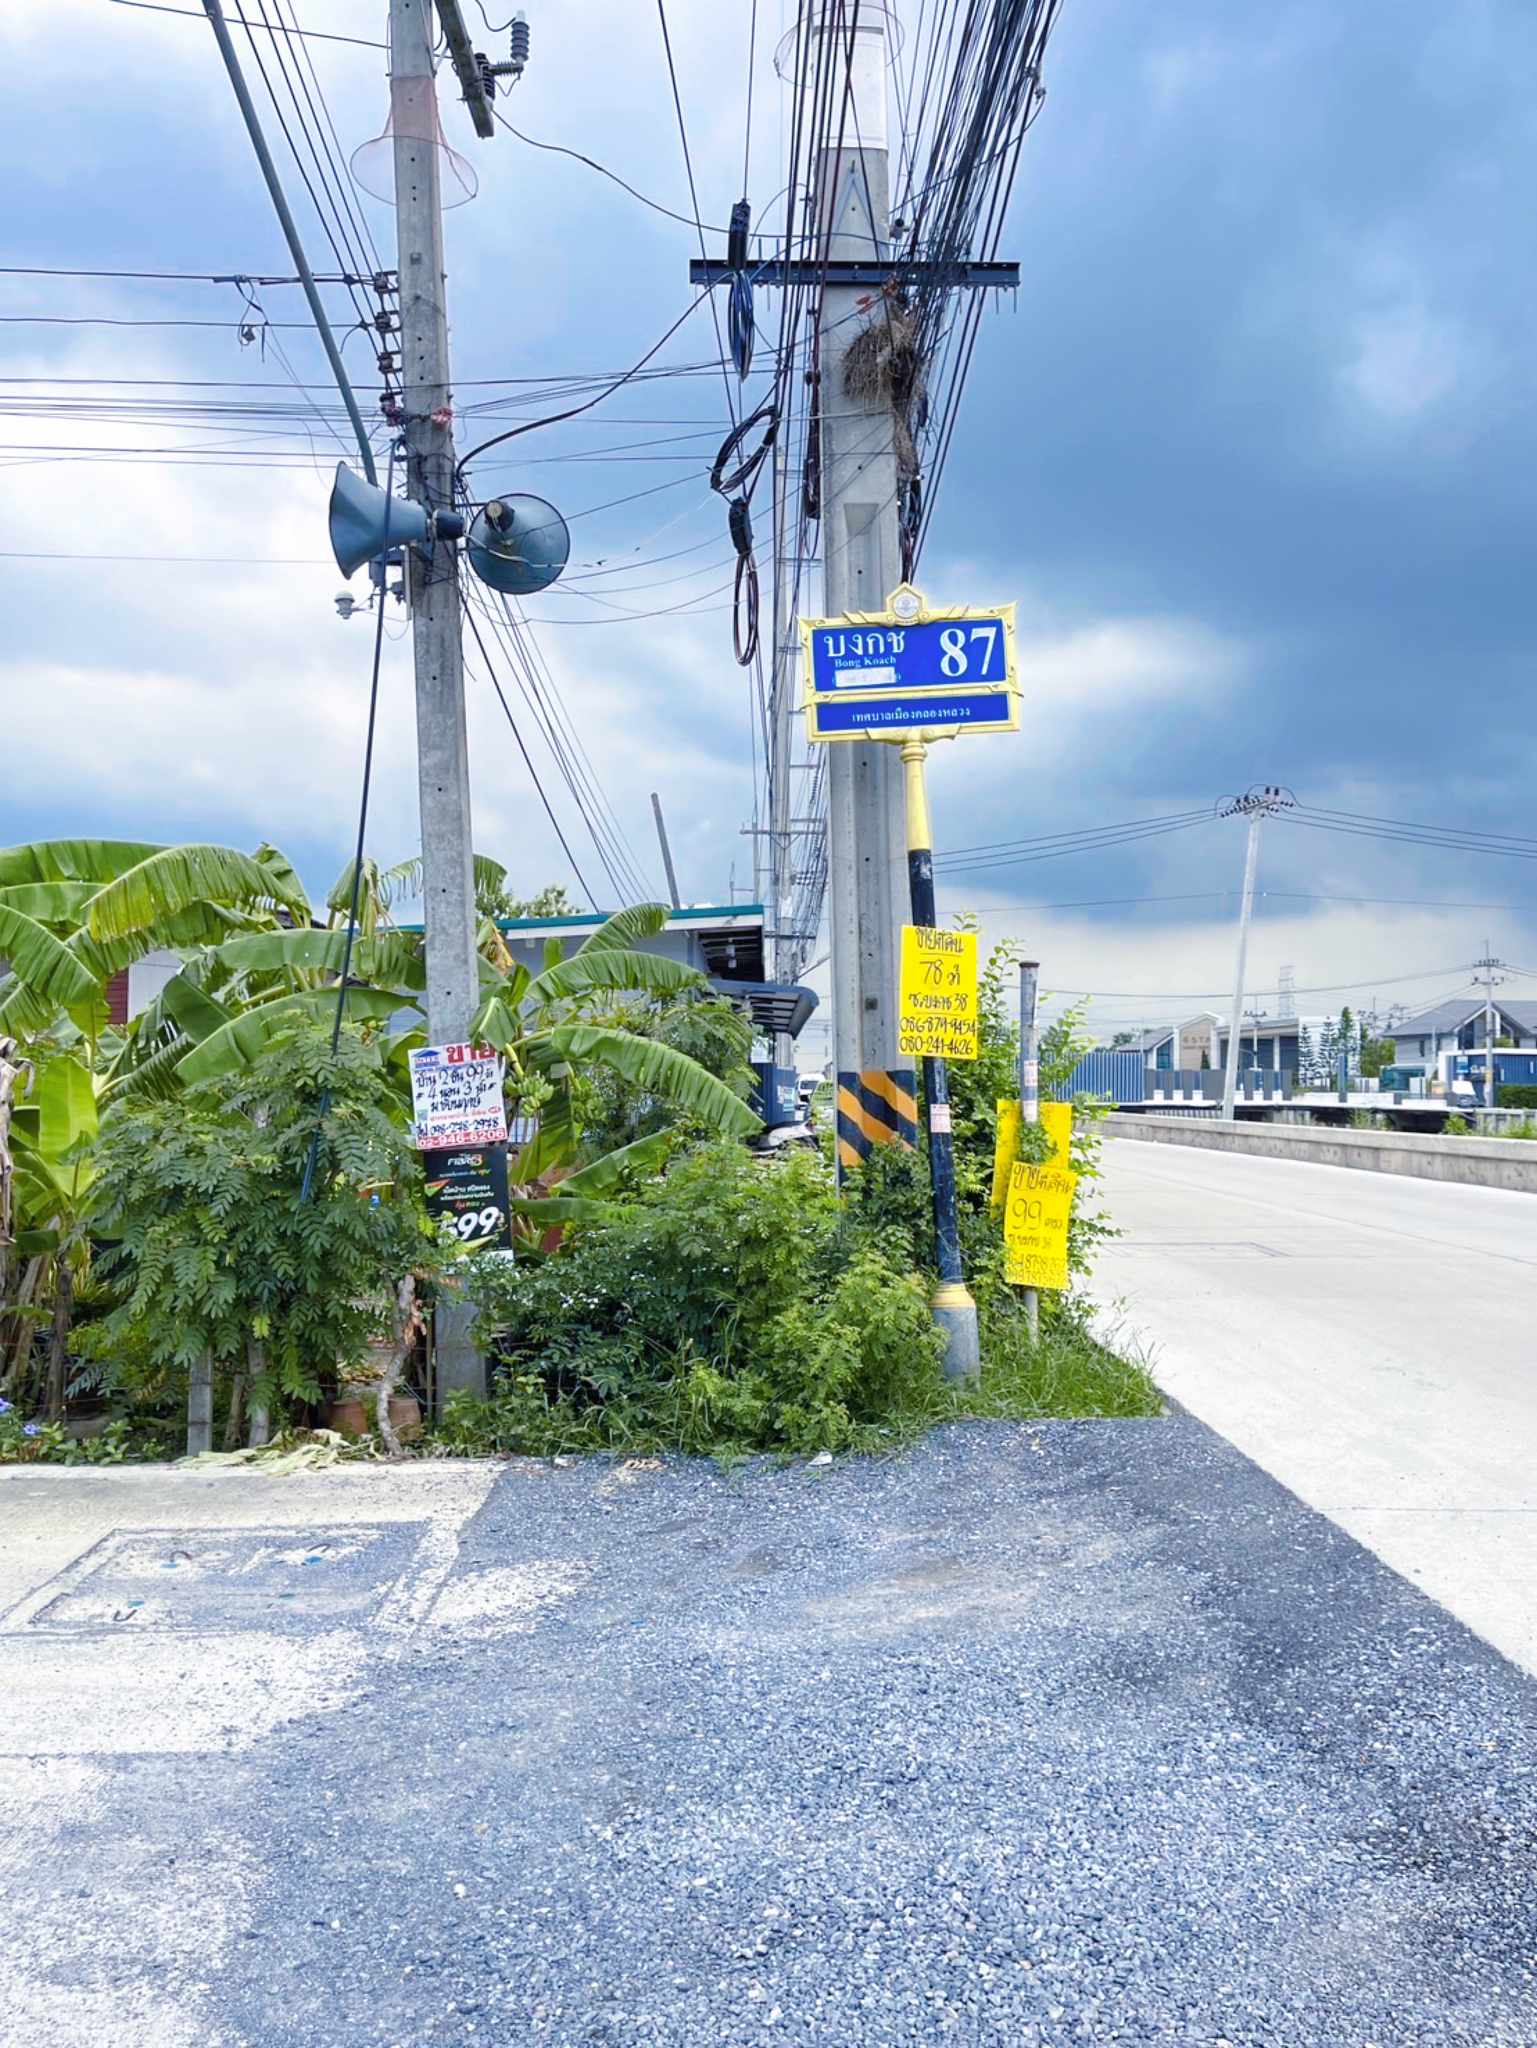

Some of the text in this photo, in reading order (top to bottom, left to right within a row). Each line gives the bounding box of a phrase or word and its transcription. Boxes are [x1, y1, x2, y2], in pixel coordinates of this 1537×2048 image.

[823, 627, 997, 677] บงกช 87
[835, 658, 861, 668] Bong
[920, 960, 943, 985] 78
[446, 1043, 496, 1064] ขาย
[439, 1069, 449, 1085] 2
[462, 1080, 472, 1096] 3
[1012, 1198, 1042, 1230] 99
